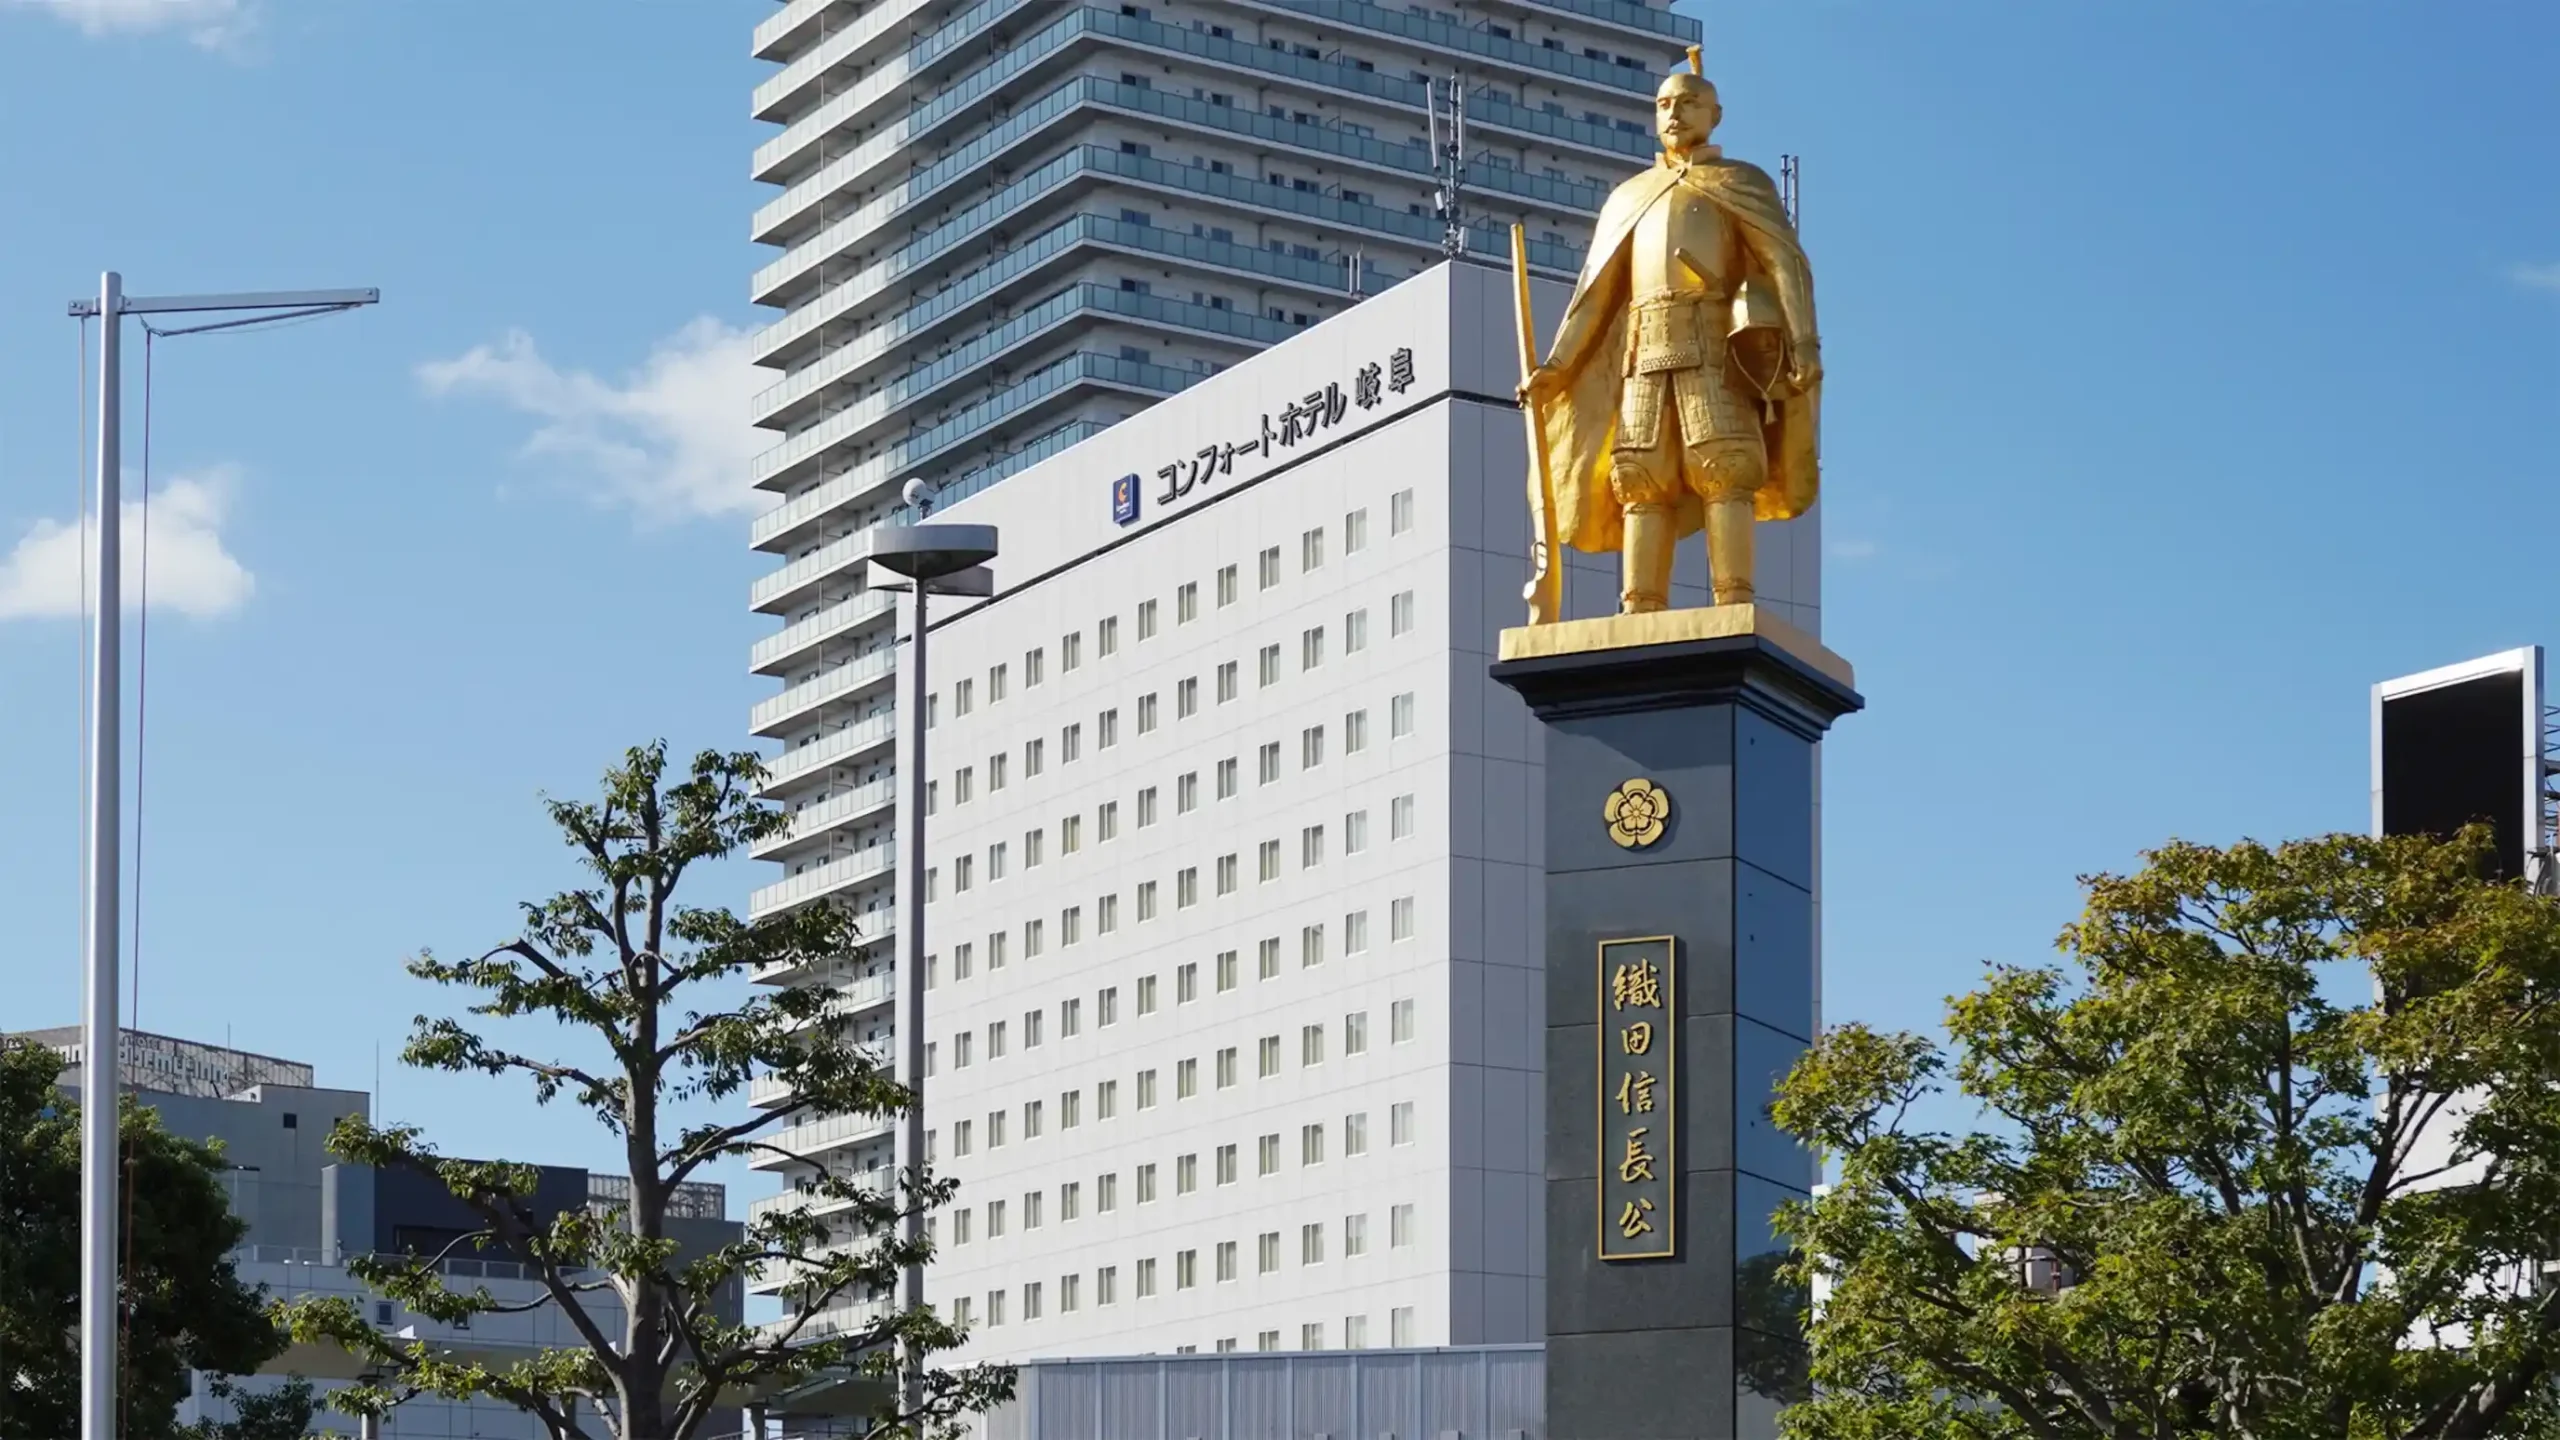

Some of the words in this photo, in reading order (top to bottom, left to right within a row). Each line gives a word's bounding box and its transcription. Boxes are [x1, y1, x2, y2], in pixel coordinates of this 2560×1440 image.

[1612, 958, 1660, 1238] 織田信長公
